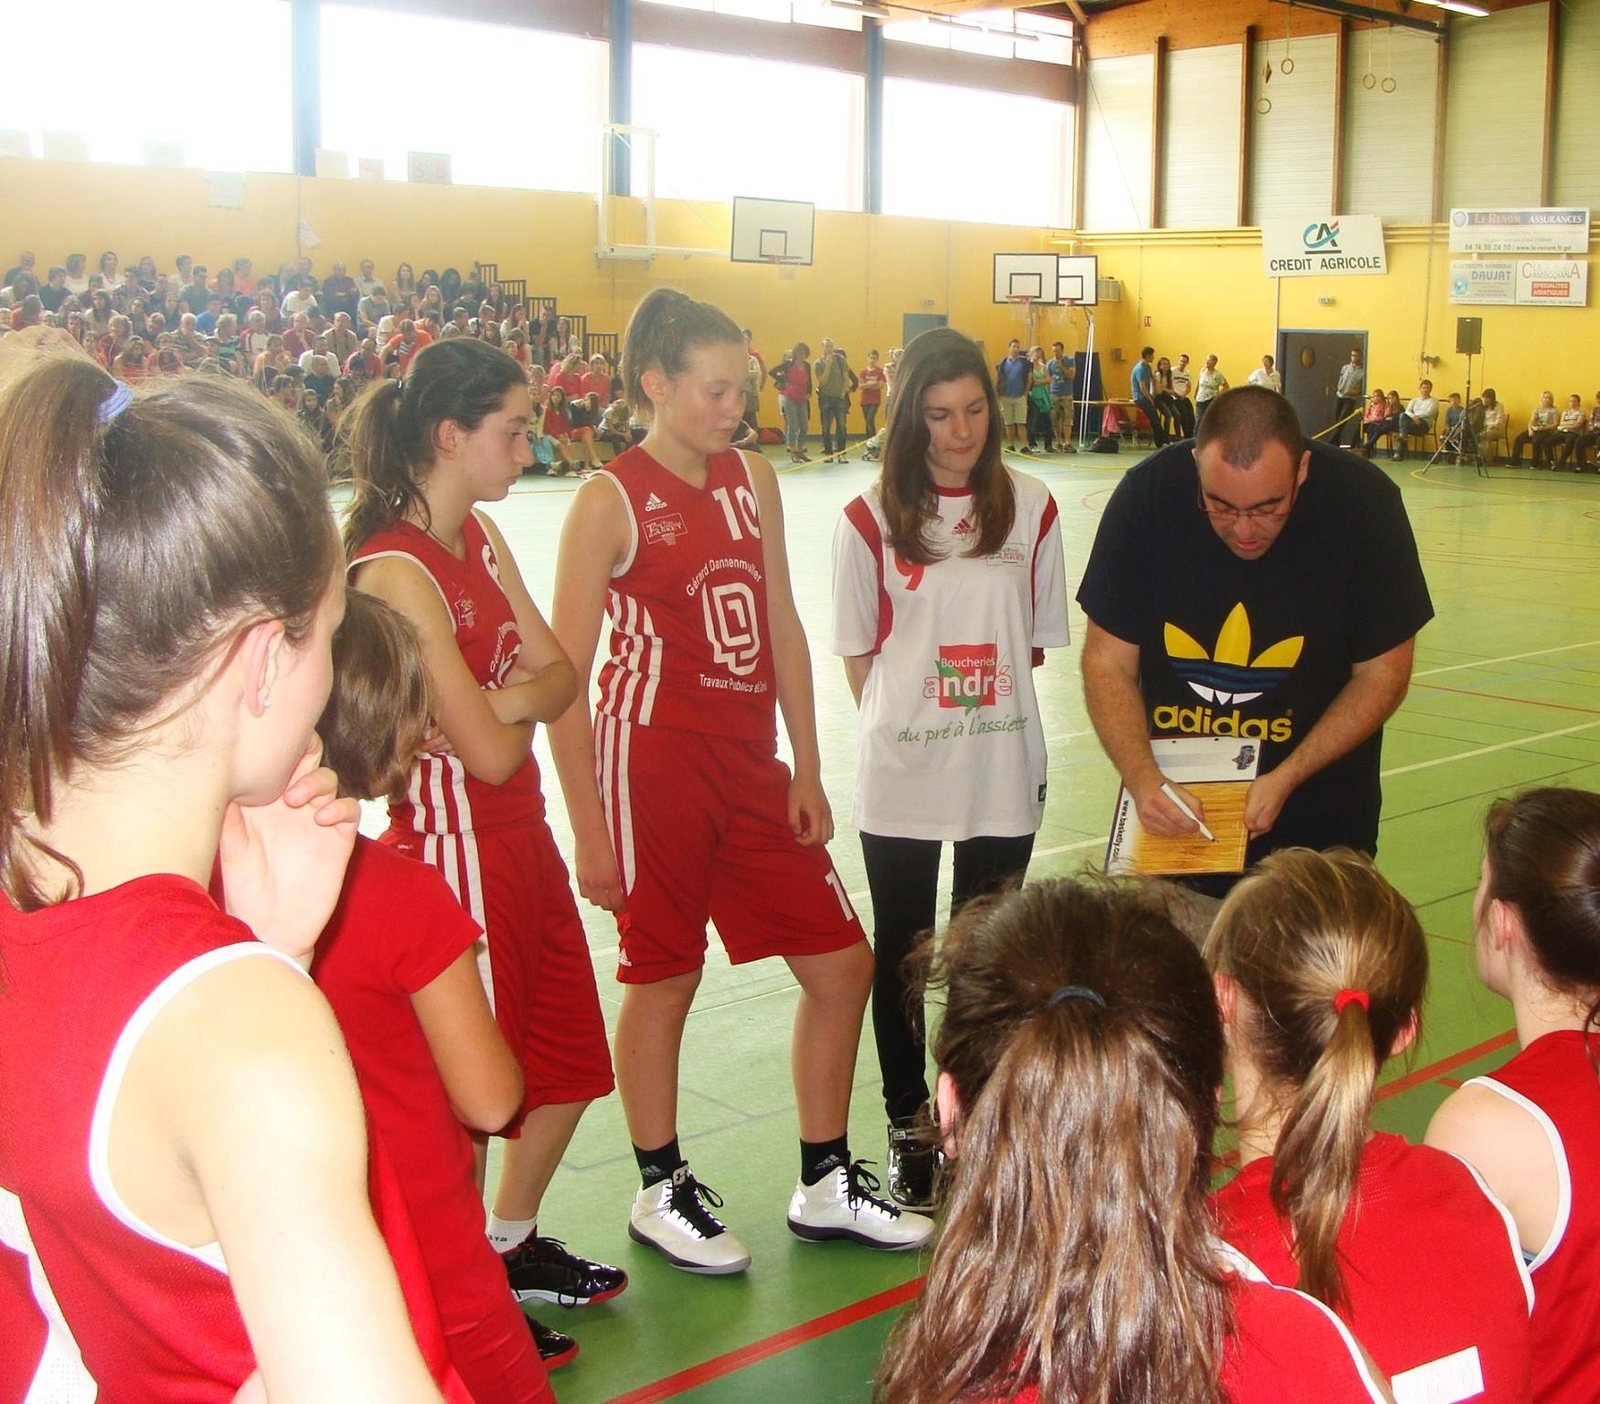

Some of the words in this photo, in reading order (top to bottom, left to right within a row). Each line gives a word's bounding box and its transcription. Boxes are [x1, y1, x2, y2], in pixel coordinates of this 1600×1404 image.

[1528, 215, 1583, 224] ASSURANCES
[1270, 259, 1312, 271] CREDIT
[1320, 257, 1381, 270] AGRICOLE
[1472, 270, 1511, 280] DAUJAT
[941, 657, 996, 667] Boucheries
[700, 674, 728, 689] Travaux
[923, 665, 1012, 699] andré
[1153, 705, 1293, 743] adidas
[898, 727, 921, 742] du
[924, 721, 951, 748] pré
